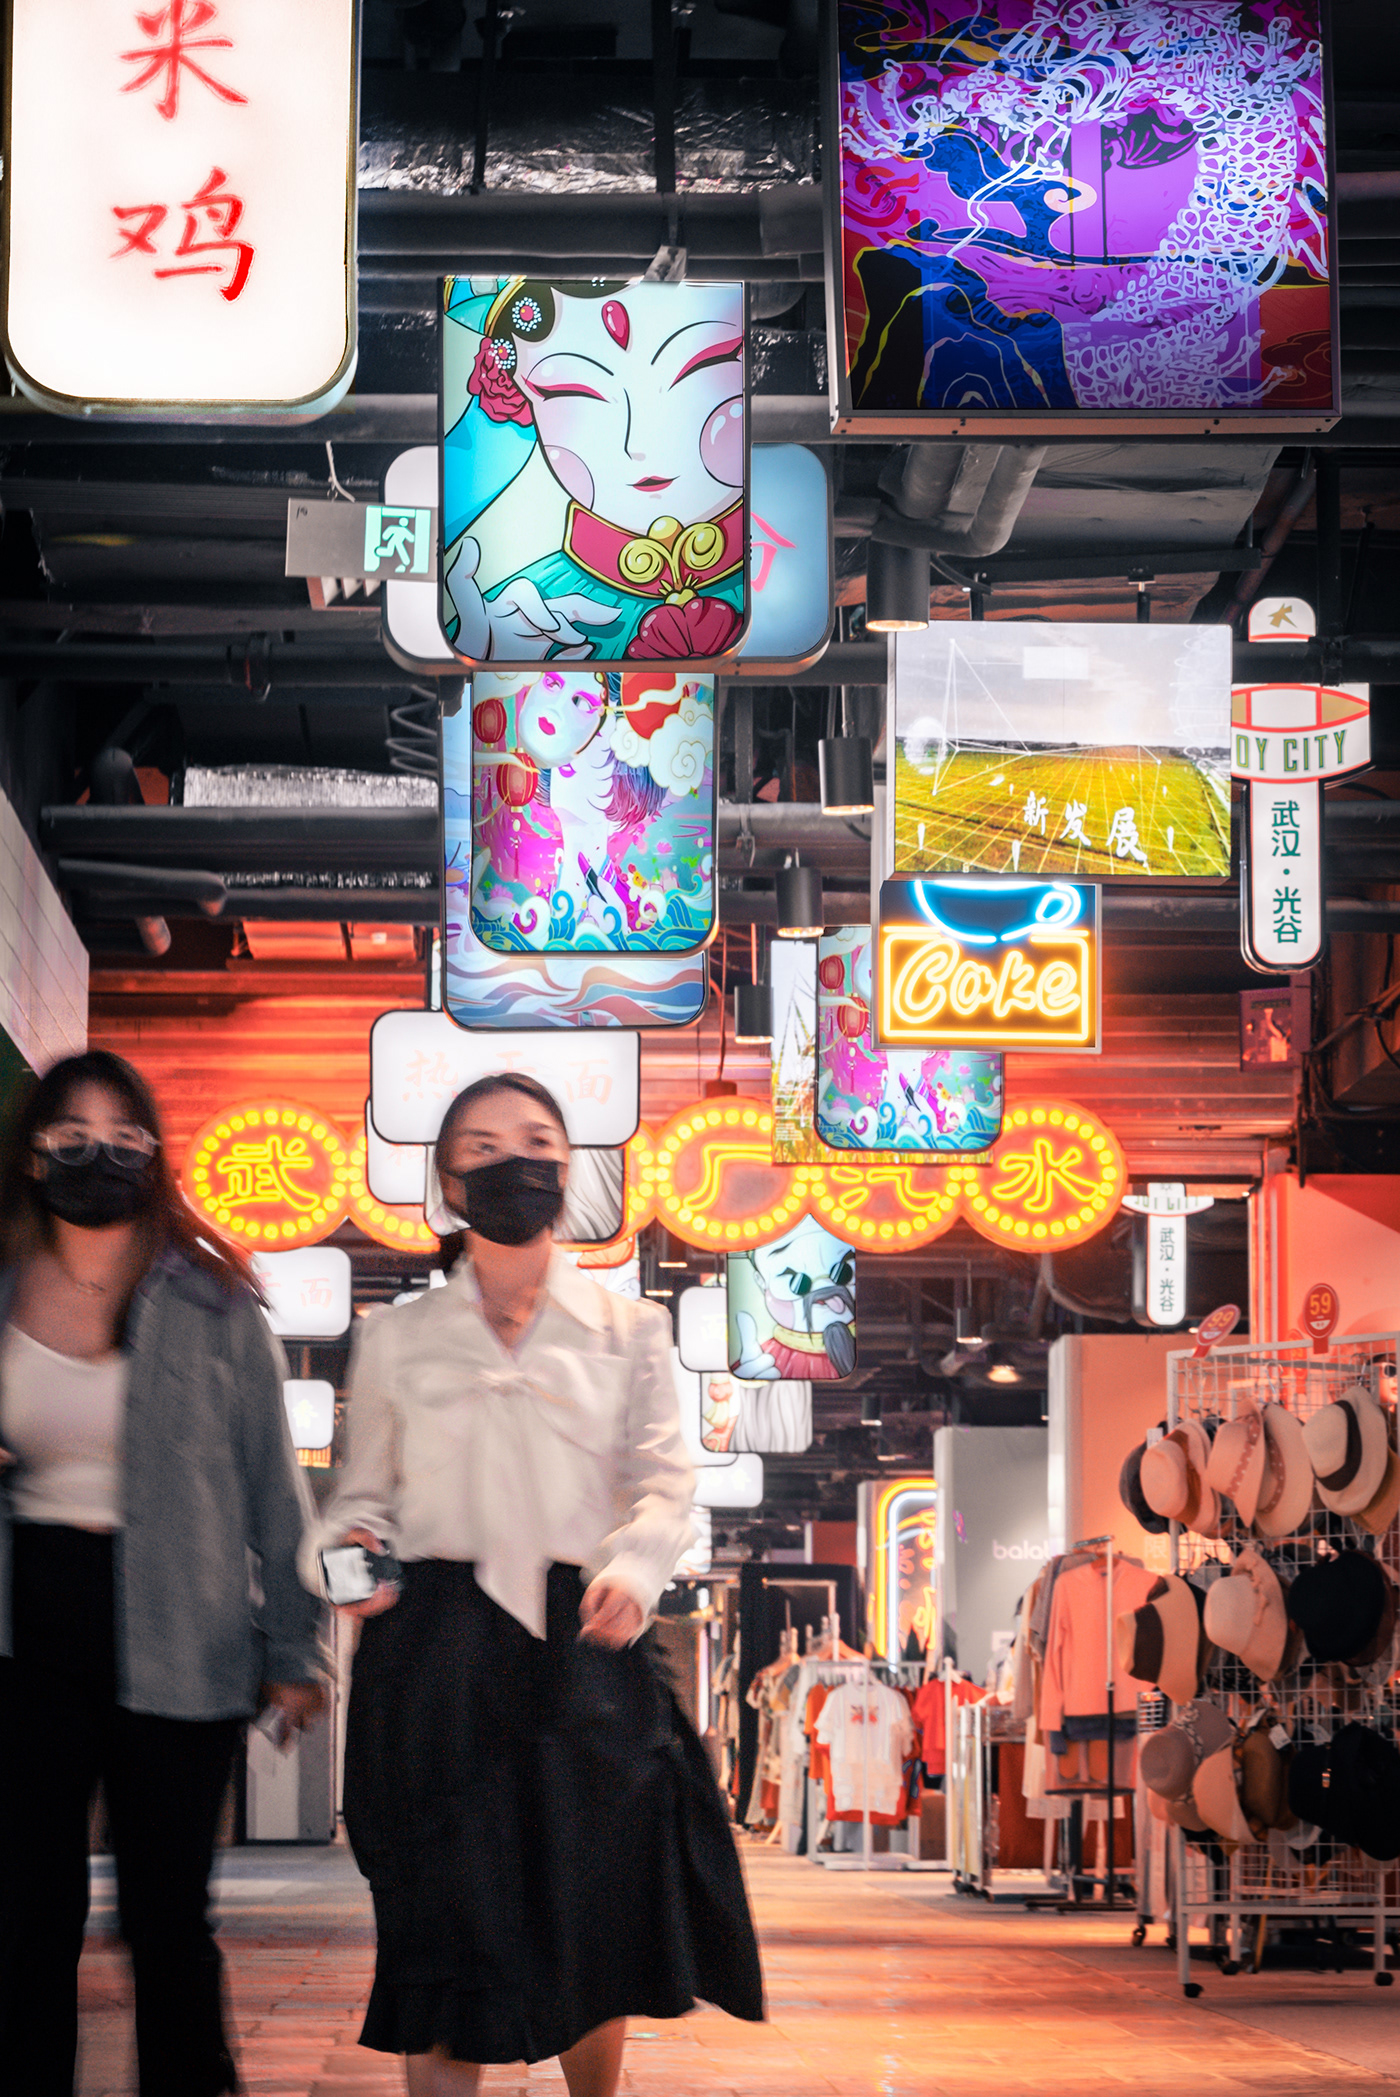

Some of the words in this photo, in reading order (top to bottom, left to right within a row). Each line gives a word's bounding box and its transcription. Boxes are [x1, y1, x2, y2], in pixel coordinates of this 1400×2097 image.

[109, 0, 255, 302] 米鸡
[1235, 733, 1268, 771] OY
[1282, 729, 1347, 773] CITY
[1022, 790, 1149, 868] 新发展
[1309, 1292, 1332, 1316] 59
